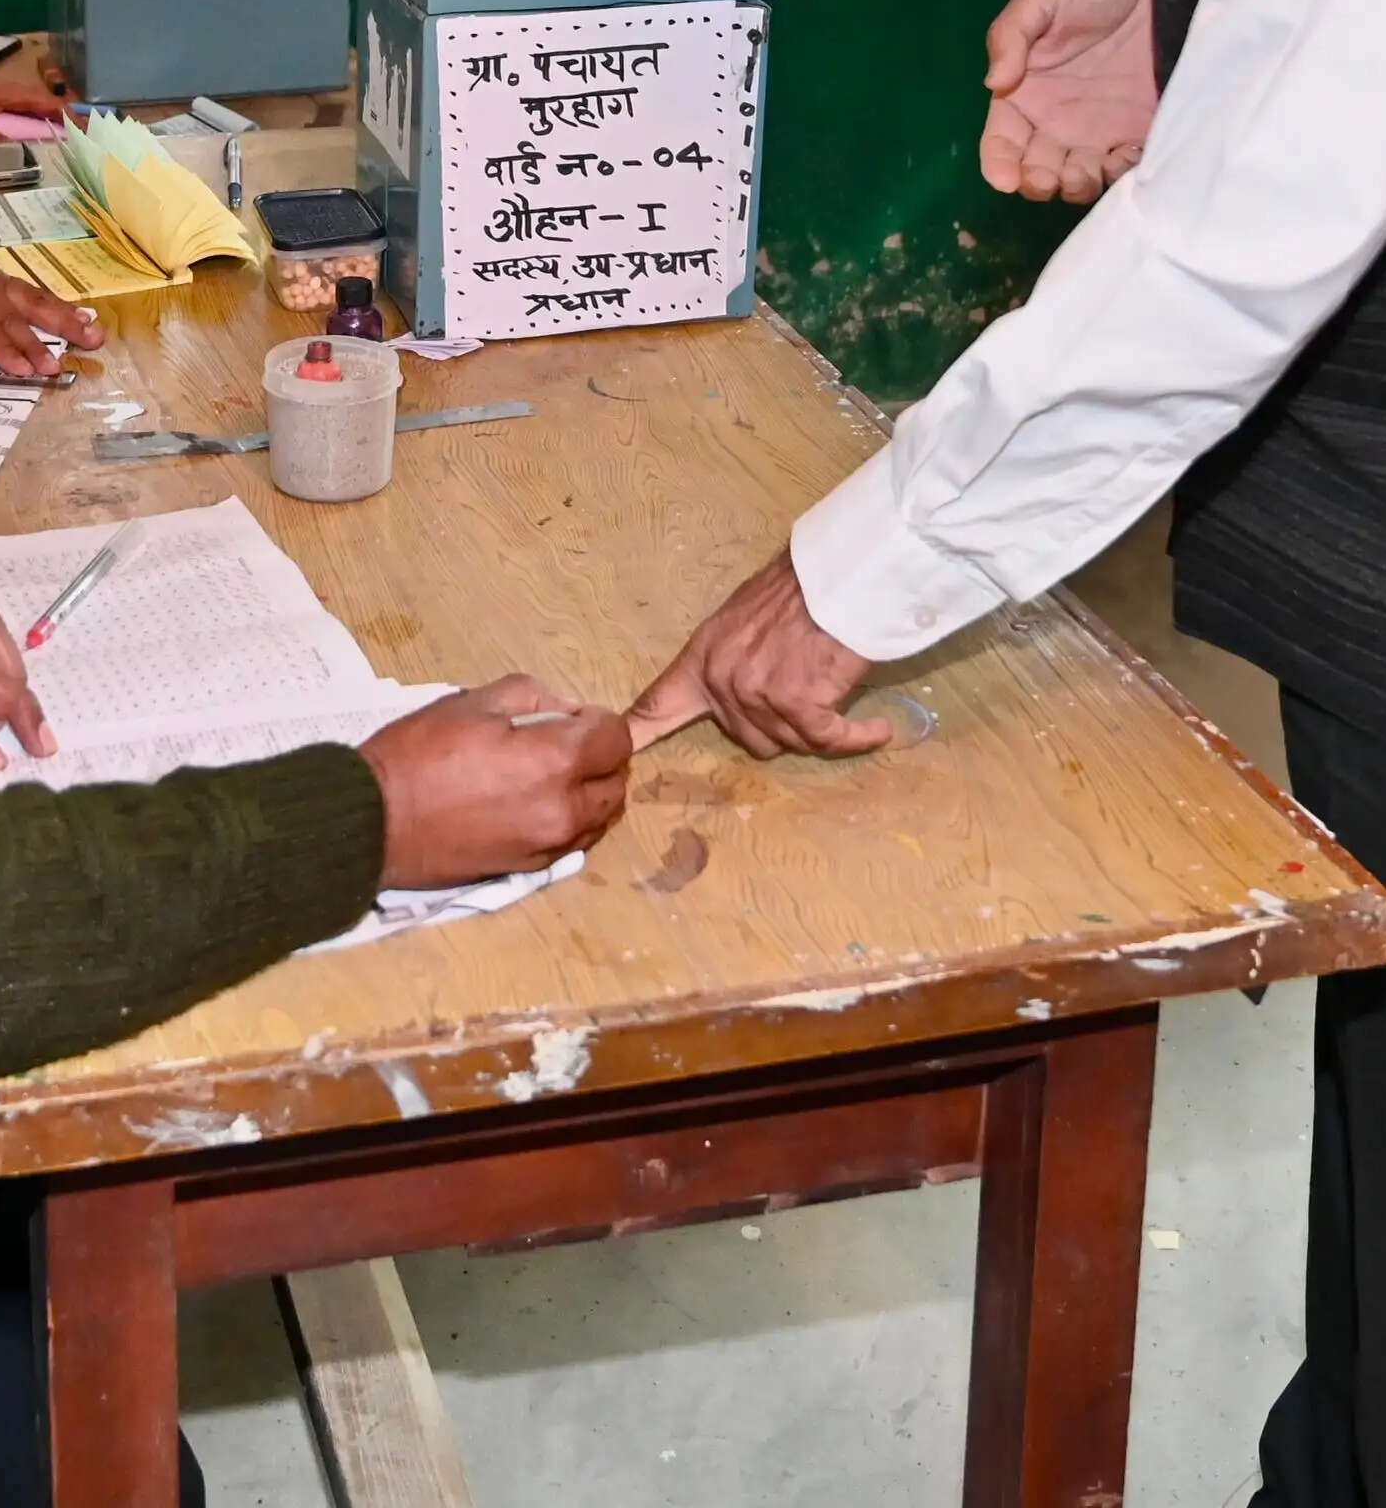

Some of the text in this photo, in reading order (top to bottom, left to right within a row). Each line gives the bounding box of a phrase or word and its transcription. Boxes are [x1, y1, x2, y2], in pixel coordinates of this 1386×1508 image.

[530, 42, 670, 84] पंचायत
[484, 140, 547, 186] वार्ड
[522, 288, 632, 317] प्रधान
